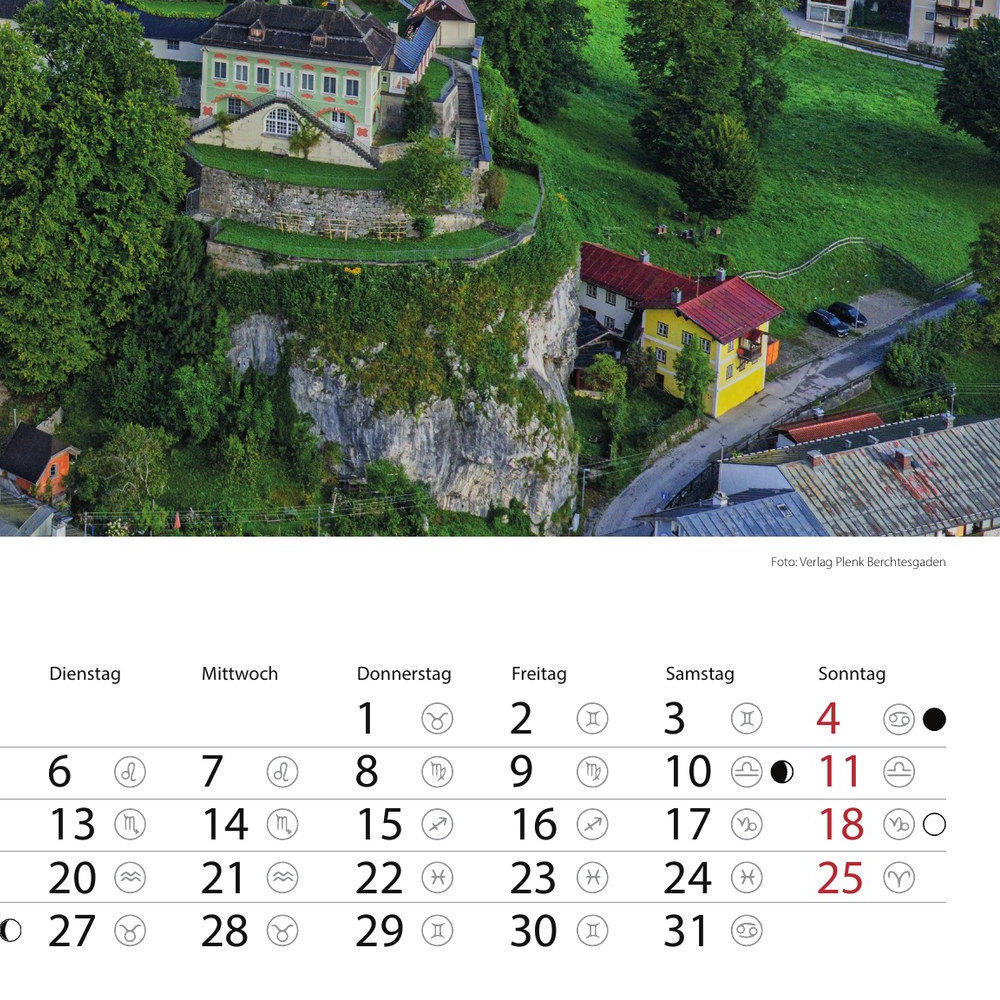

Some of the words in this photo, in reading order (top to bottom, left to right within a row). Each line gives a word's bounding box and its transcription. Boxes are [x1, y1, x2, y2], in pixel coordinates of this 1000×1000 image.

[49, 665, 121, 685] Dienstag
[201, 665, 278, 681] Mittwoch
[357, 665, 452, 685] Donnerstag
[512, 666, 567, 685] Freitag
[666, 665, 735, 685] Samstag
[818, 665, 886, 685] Sonntag
[358, 701, 371, 735] 1
[510, 700, 532, 735] 2
[663, 700, 685, 735] 3
[816, 701, 841, 735] 4
[48, 753, 72, 788] 6
[201, 754, 224, 788] 7
[355, 753, 379, 788] 8
[510, 753, 533, 788] 9
[666, 753, 712, 788] 10
[820, 754, 857, 788] 11
[51, 806, 95, 841] 13
[204, 807, 249, 841] 14
[358, 807, 402, 841] 15
[513, 806, 558, 841] 16
[666, 807, 711, 841] 17
[820, 806, 865, 841] 18
[48, 860, 97, 895] 20
[201, 860, 241, 895] 21
[355, 860, 403, 895] 22
[510, 860, 556, 895] 23
[663, 860, 713, 895] 24
[817, 860, 863, 895] 25
[48, 913, 96, 947] 27
[201, 913, 248, 948] 28
[355, 913, 404, 948] 29
[510, 913, 557, 948] 30
[663, 913, 704, 948] 31
